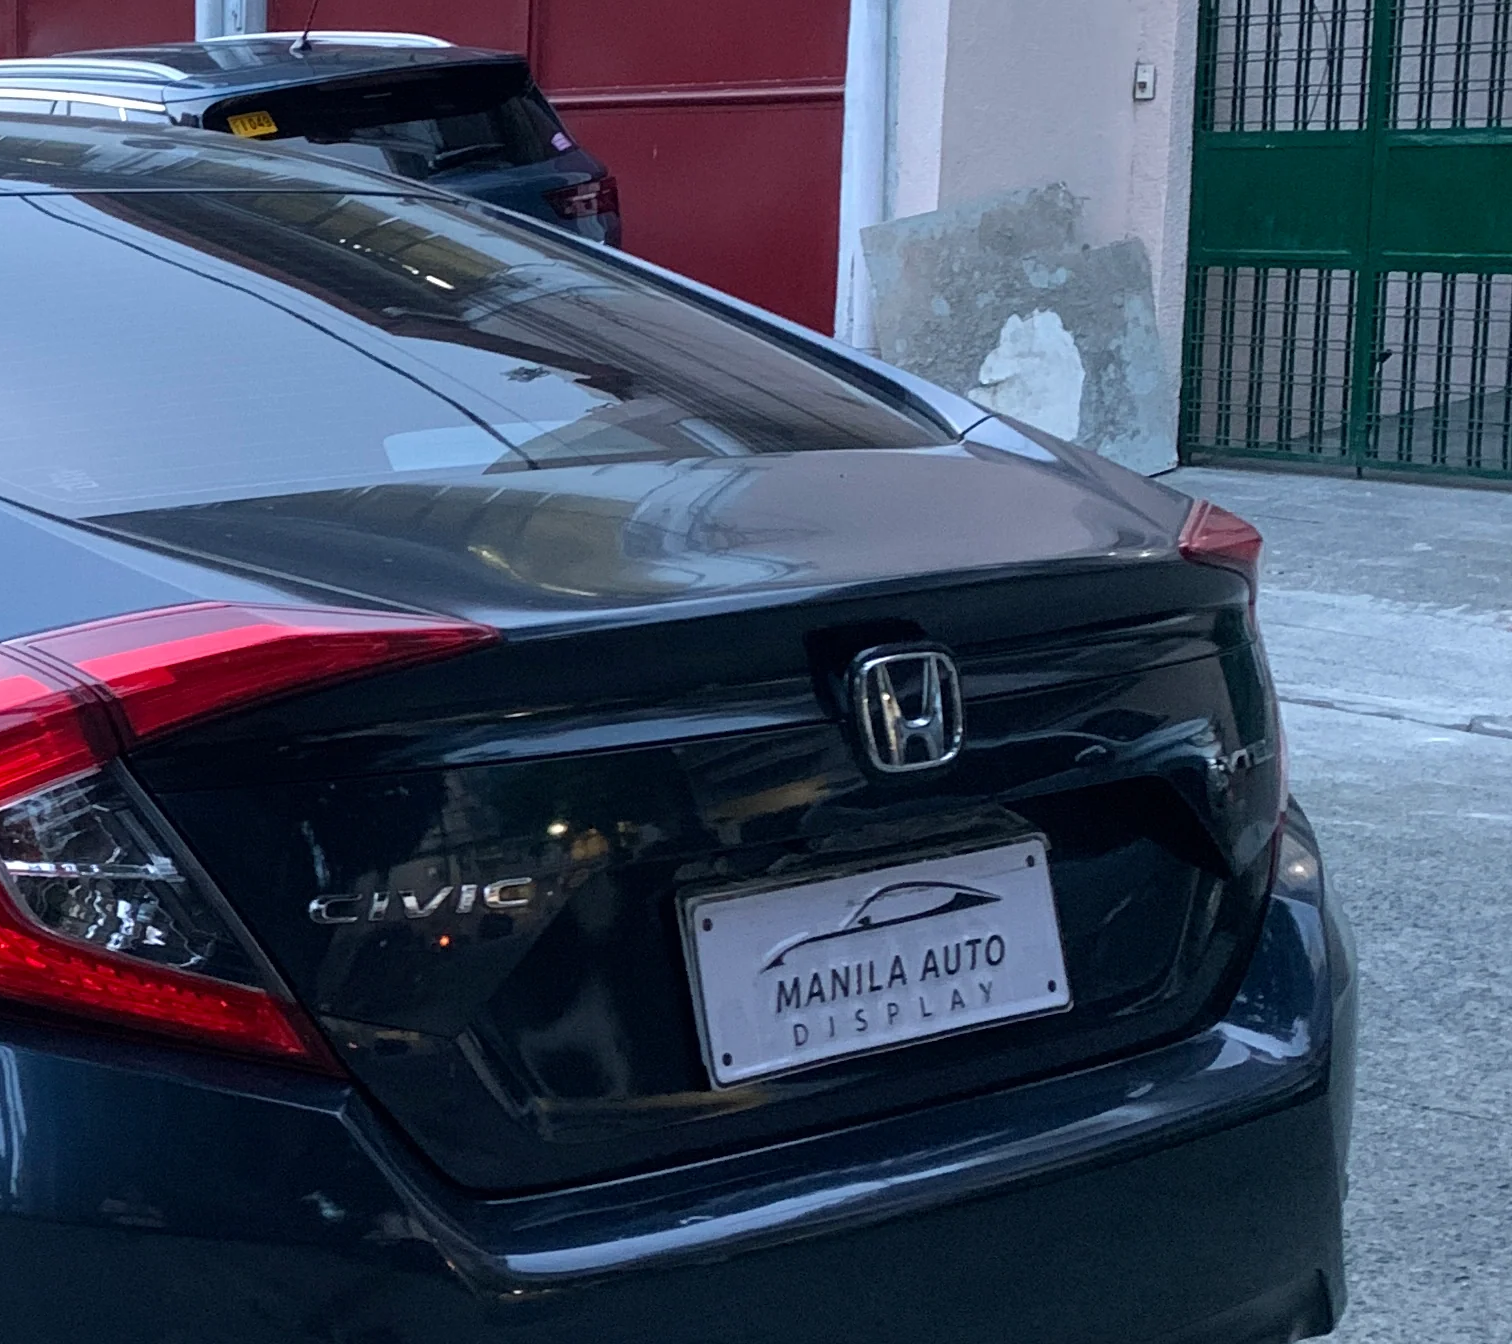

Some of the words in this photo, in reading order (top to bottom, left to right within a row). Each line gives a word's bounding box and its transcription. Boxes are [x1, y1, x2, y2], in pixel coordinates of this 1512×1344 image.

[308, 877, 532, 925] CIVIC
[776, 954, 908, 1014] MANILA
[919, 933, 1007, 982] AUTO
[793, 980, 995, 1047] DISPLAY
